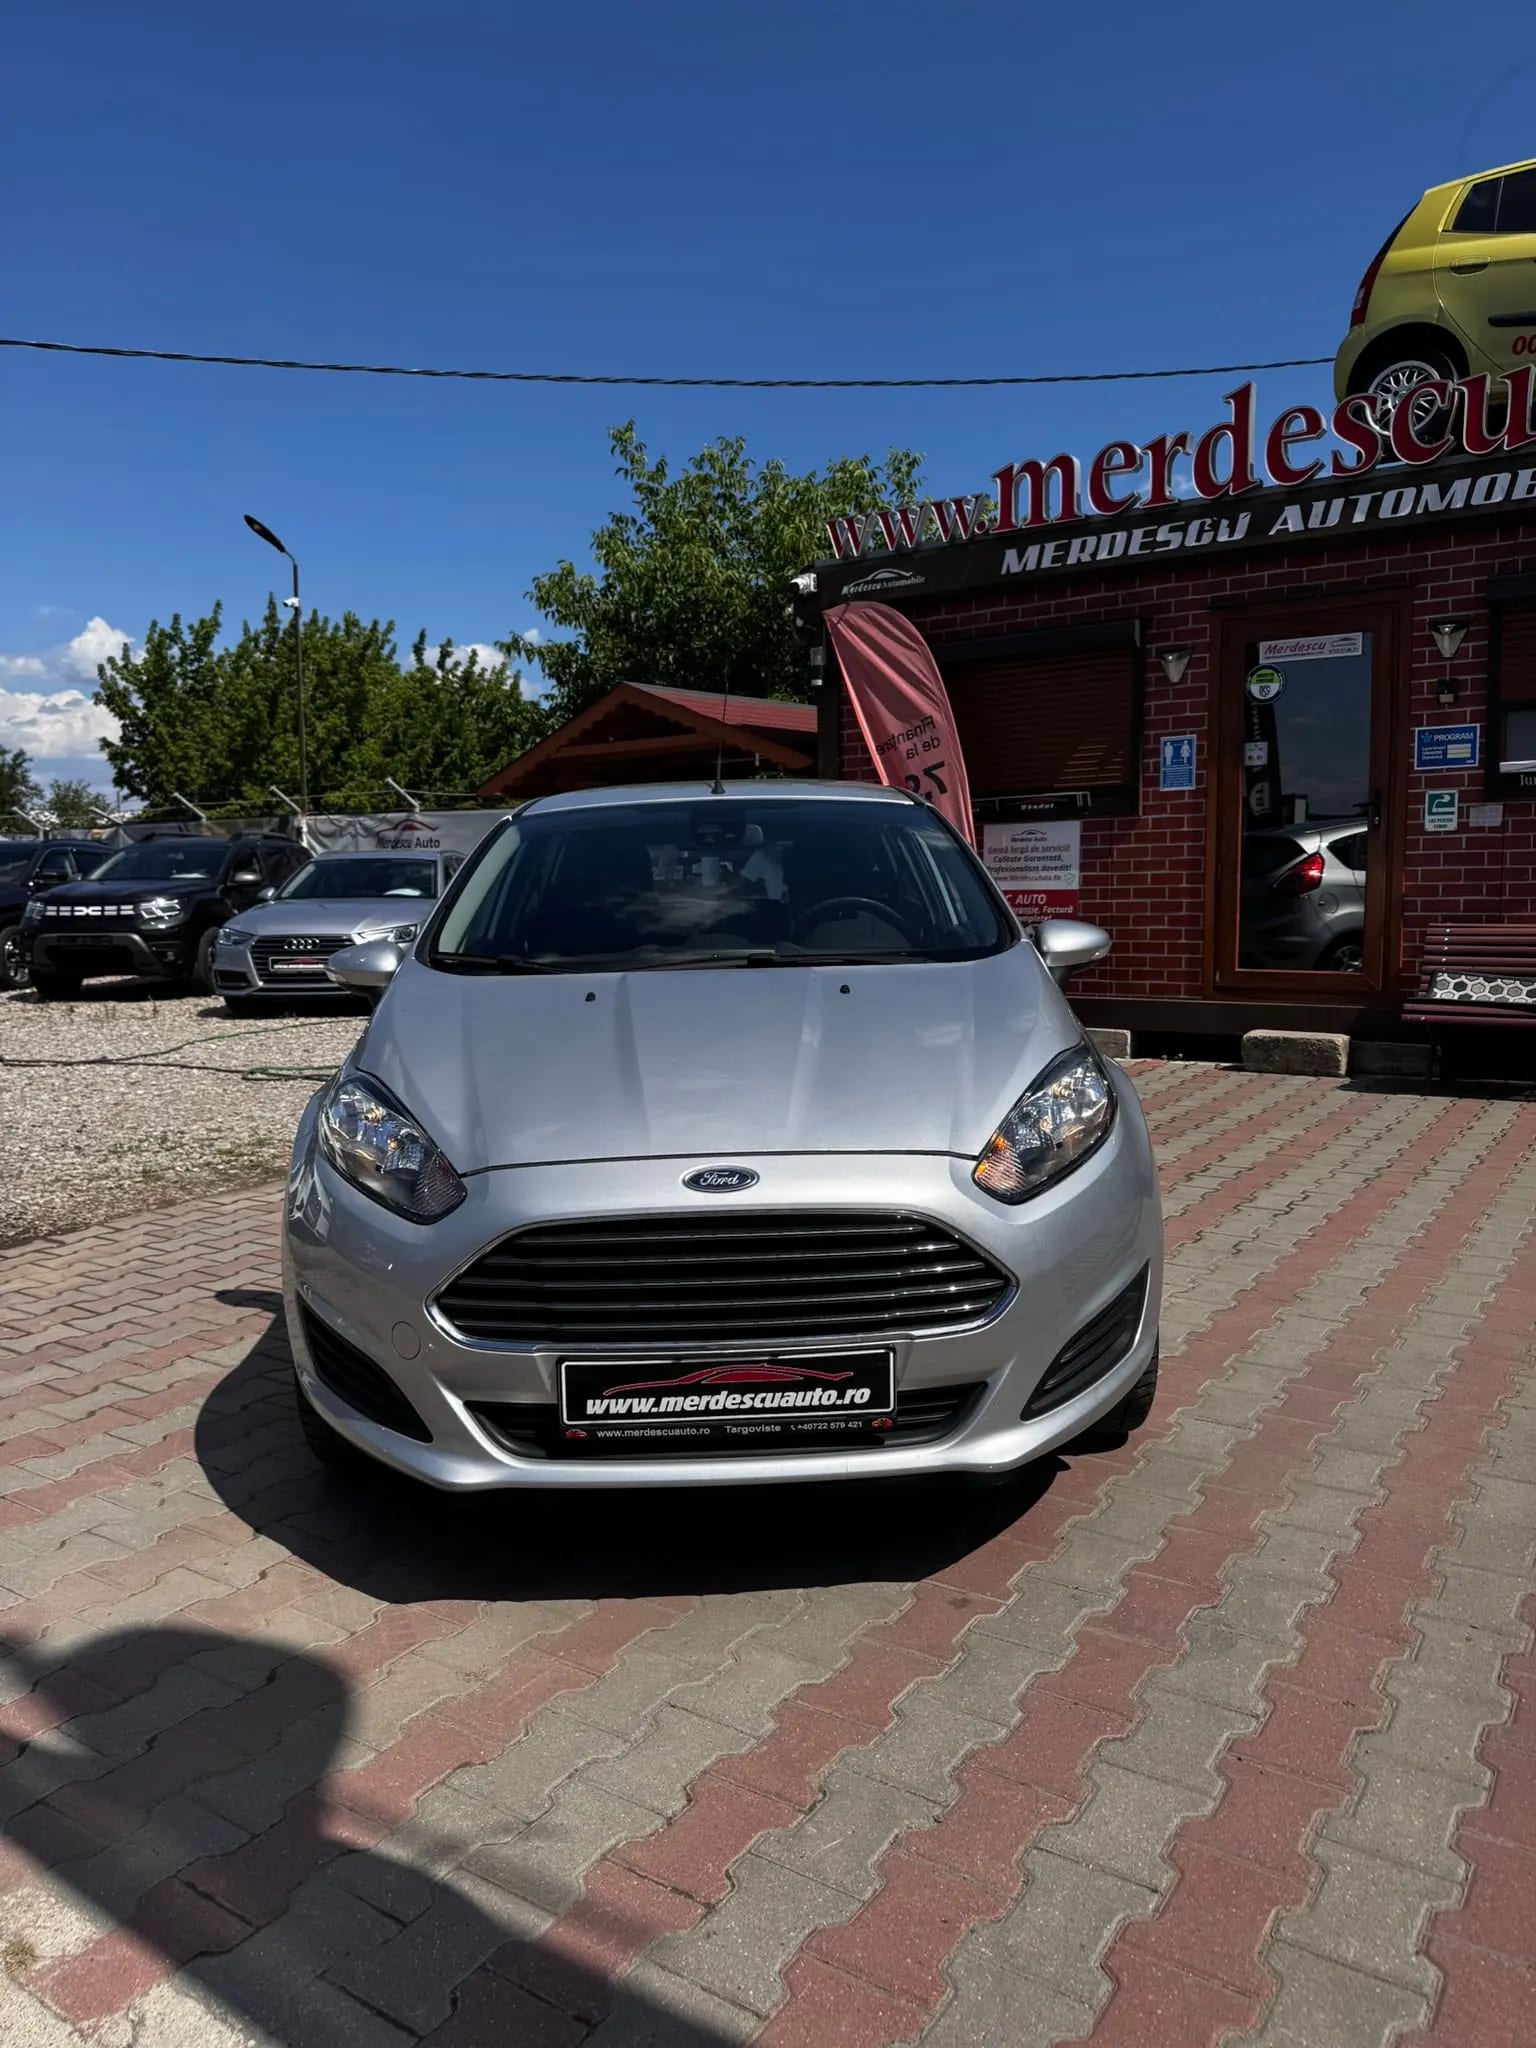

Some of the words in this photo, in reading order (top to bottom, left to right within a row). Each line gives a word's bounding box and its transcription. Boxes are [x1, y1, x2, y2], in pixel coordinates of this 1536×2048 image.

[1001, 511, 1252, 575] MERDESCU
[1264, 641, 1328, 656] Merdescu
[1433, 732, 1474, 742] PROGRAM
[415, 836, 440, 849] Auto
[1015, 894, 1046, 905] AUTO
[700, 1171, 739, 1186] Ford
[586, 1387, 871, 1415] www.merdescuauto.ro
[596, 1427, 711, 1439] www.merdescuauto.ro
[724, 1424, 781, 1435] Targoviste
[847, 1420, 863, 1429] 421
